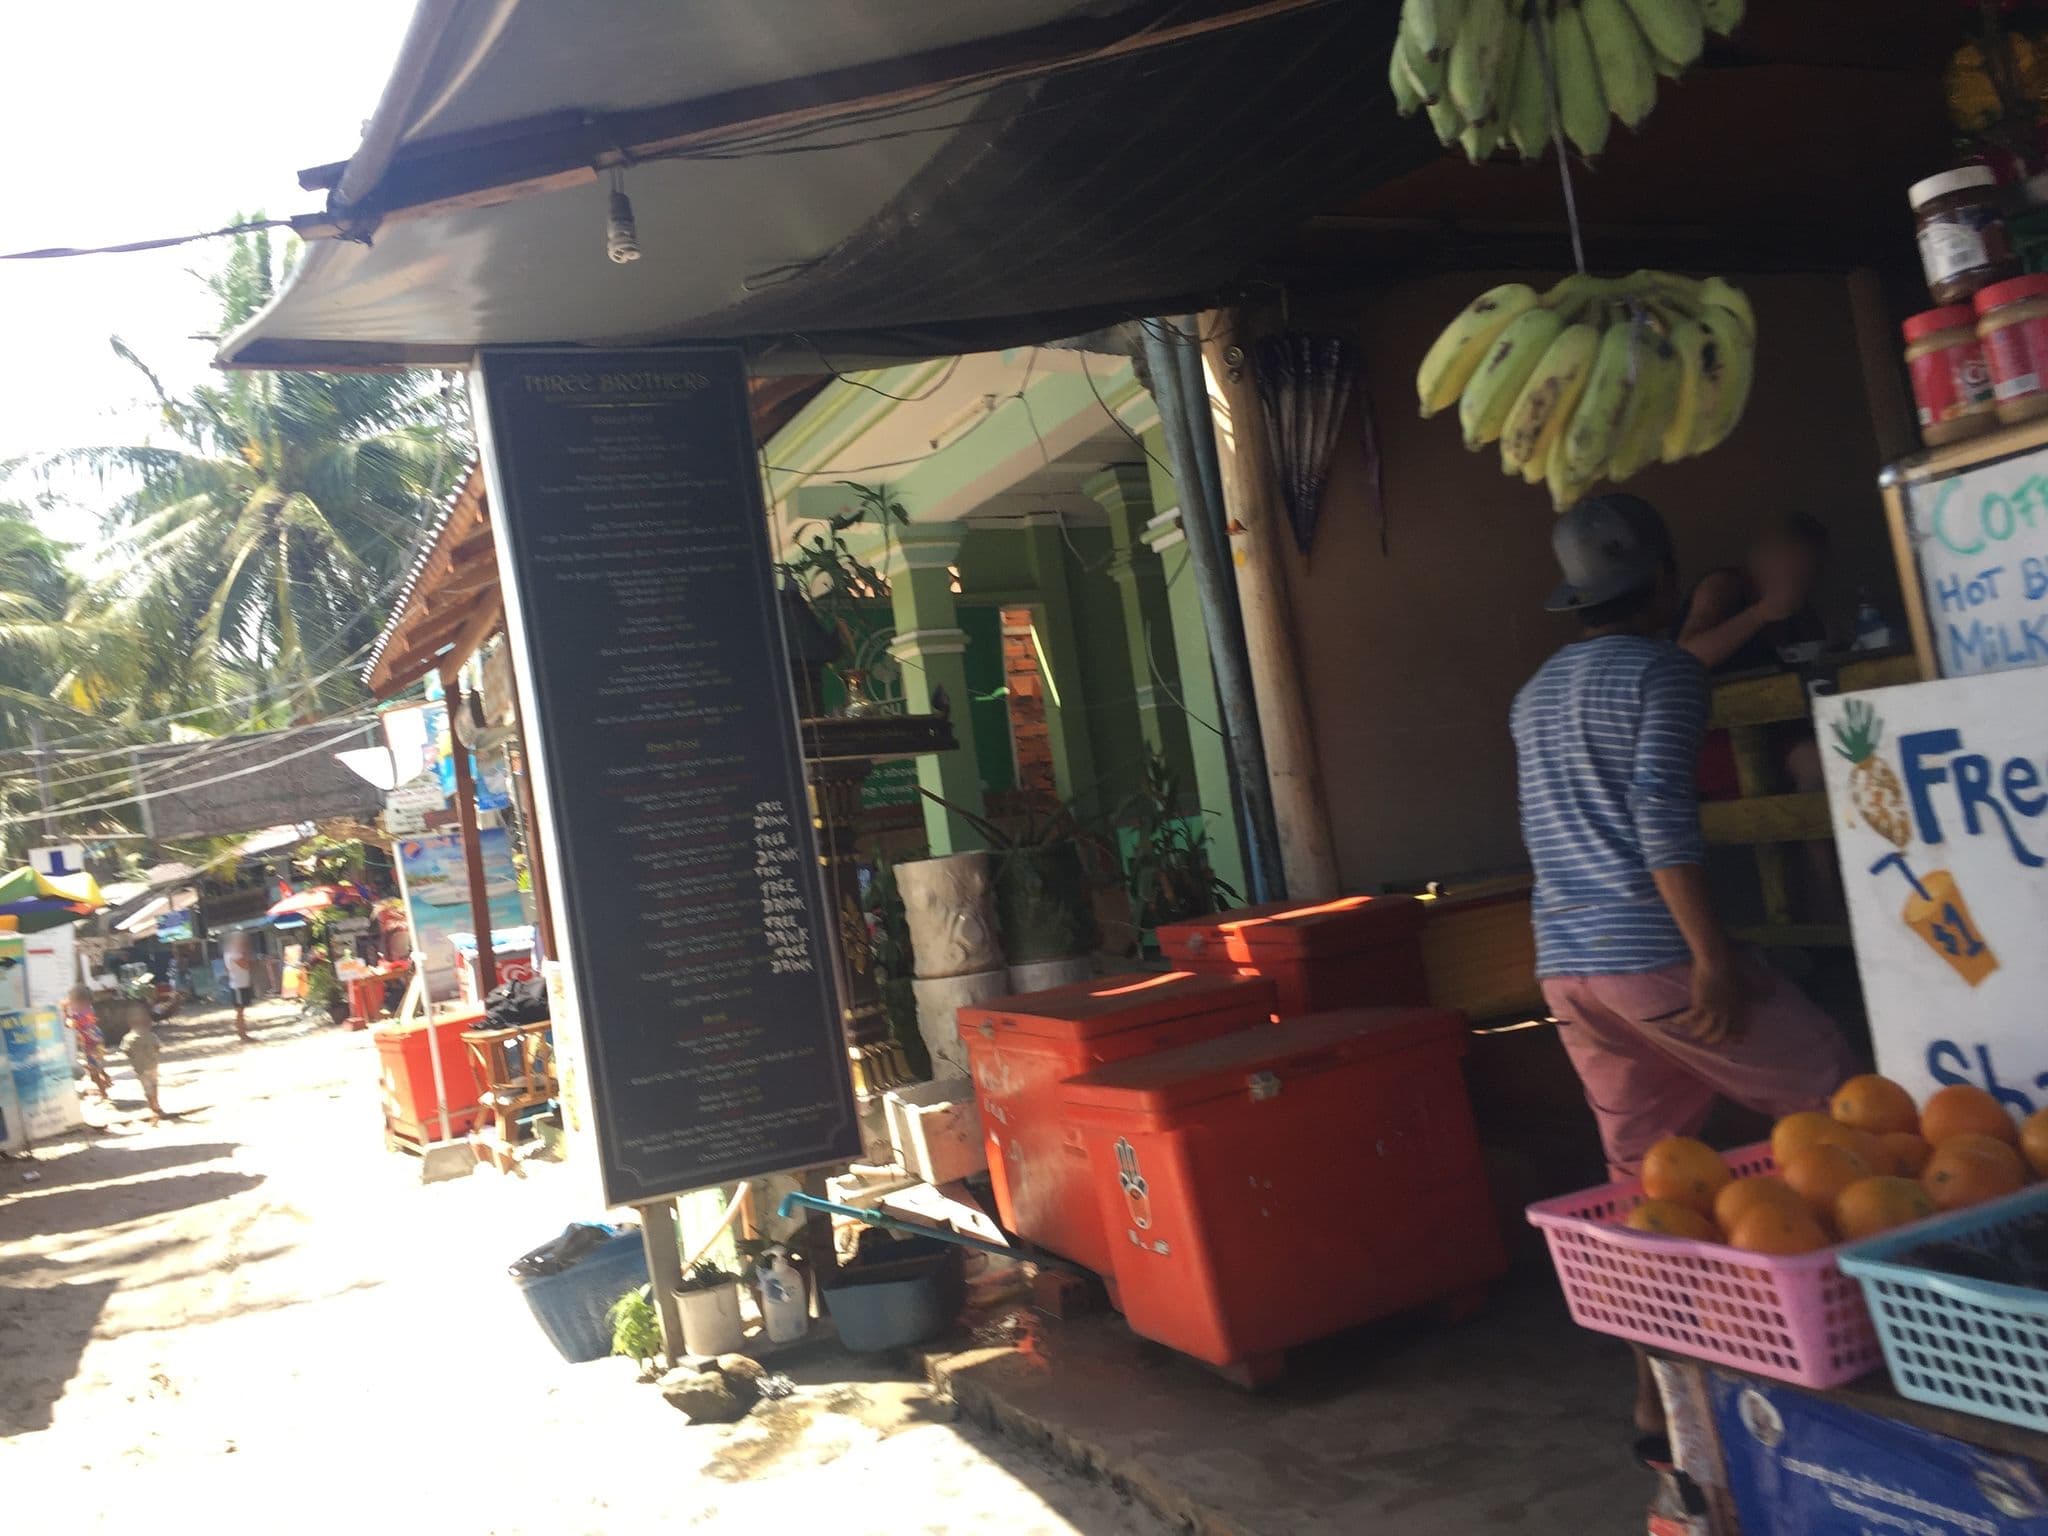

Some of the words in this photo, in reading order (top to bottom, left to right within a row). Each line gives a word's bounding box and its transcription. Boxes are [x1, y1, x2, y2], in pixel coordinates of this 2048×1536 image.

[2021, 556, 2048, 601] B
[1932, 903, 1984, 956] $1
[1927, 1040, 2048, 1116] Sh
